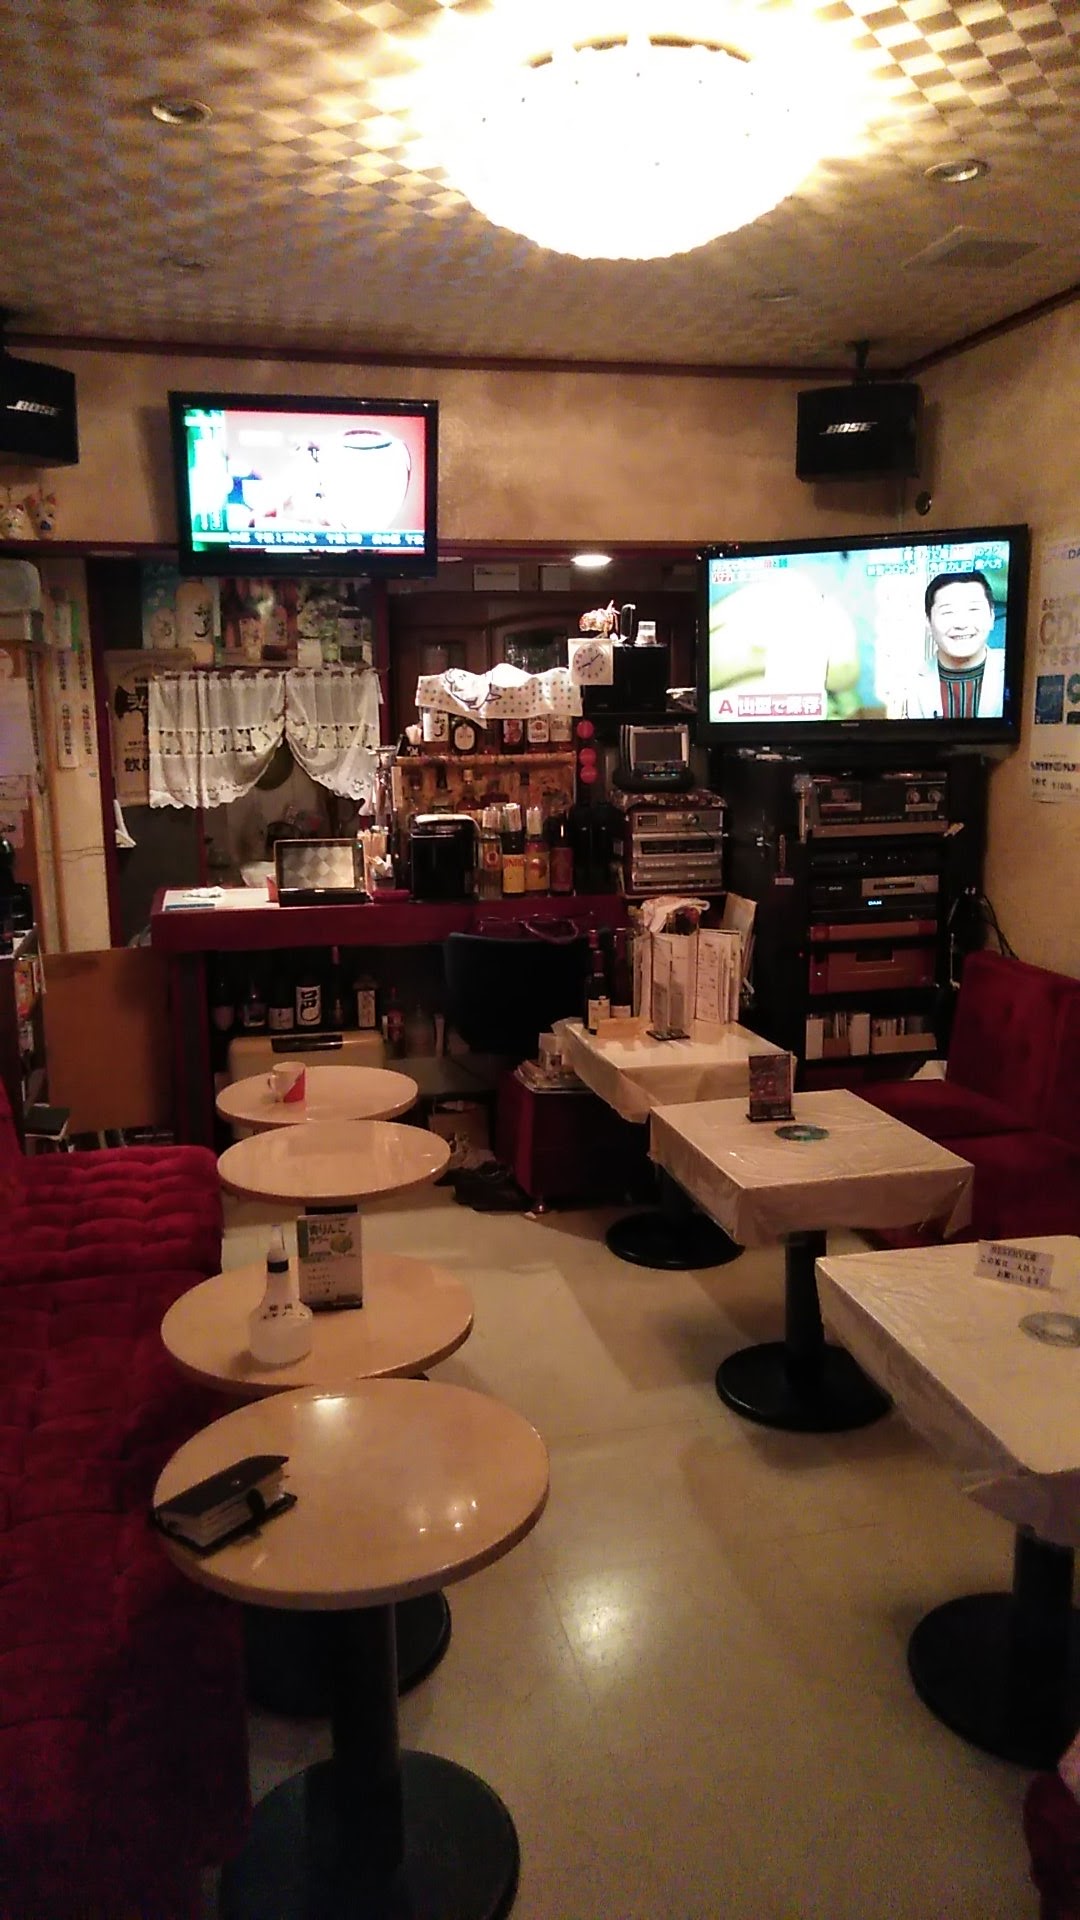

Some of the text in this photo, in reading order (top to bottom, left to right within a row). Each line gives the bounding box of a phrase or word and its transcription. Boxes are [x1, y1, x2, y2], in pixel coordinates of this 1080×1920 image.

[13, 400, 57, 416] BOSE
[824, 421, 875, 434] BOSE
[718, 699, 733, 714] A
